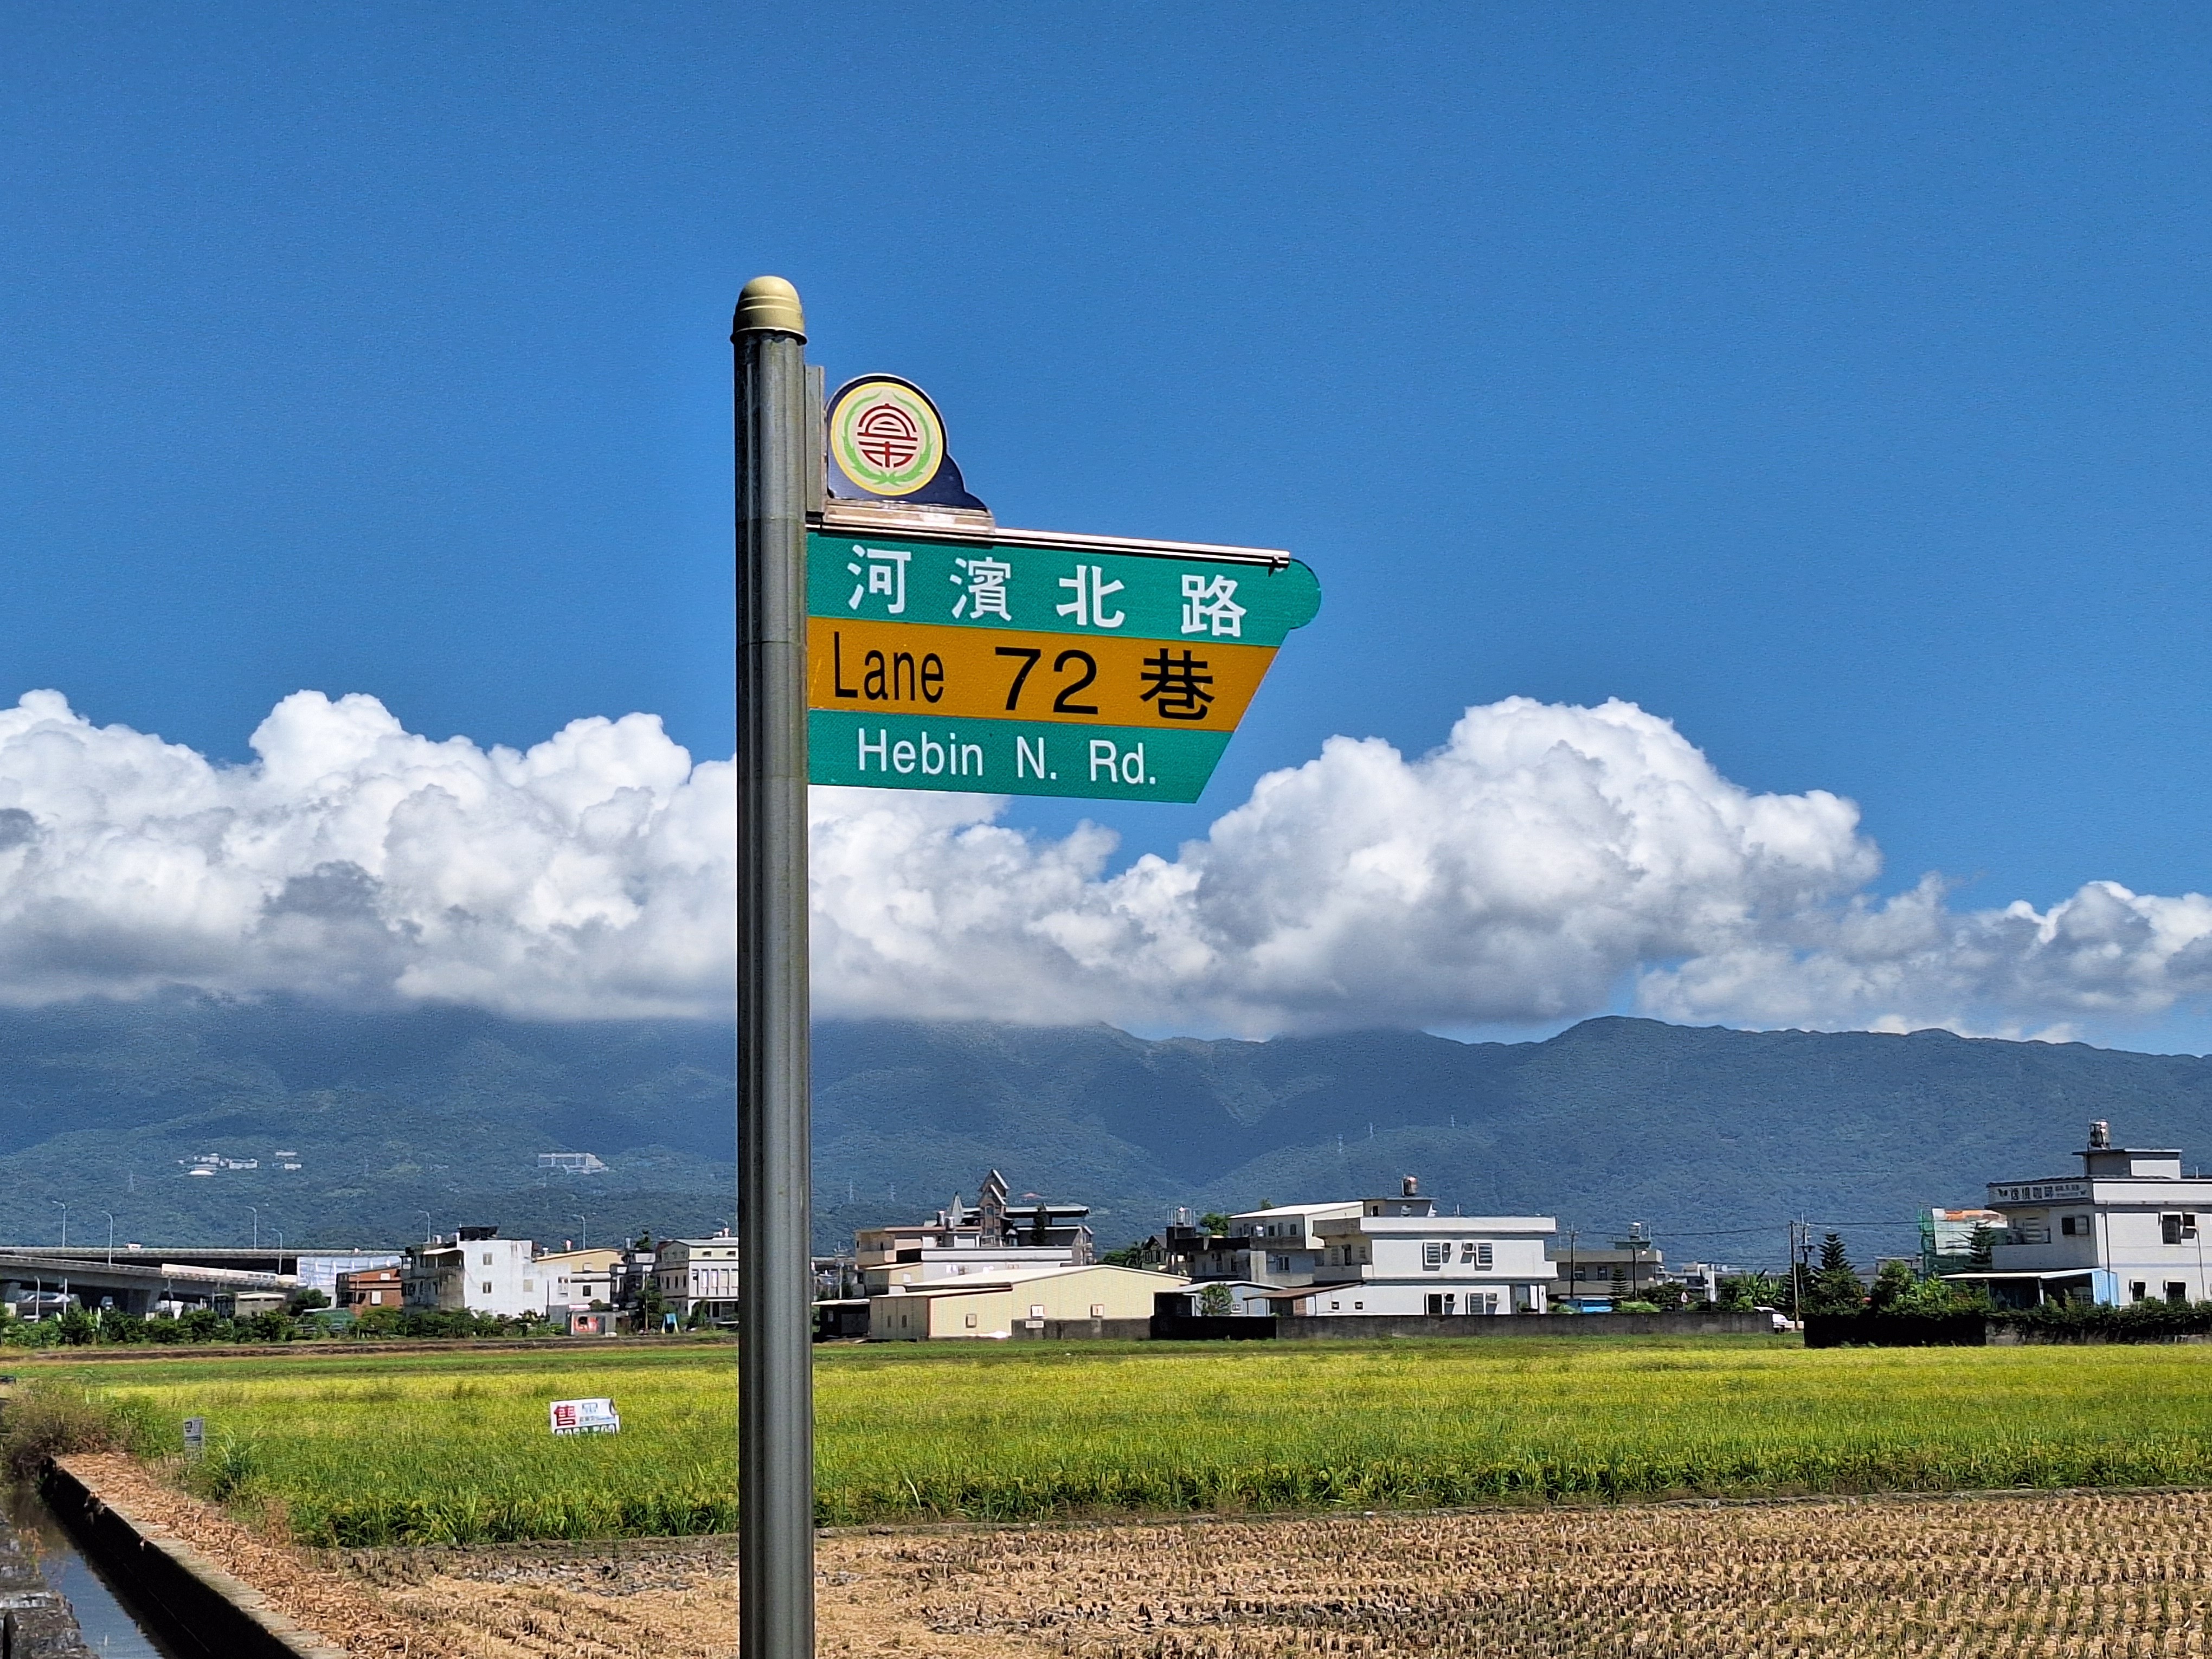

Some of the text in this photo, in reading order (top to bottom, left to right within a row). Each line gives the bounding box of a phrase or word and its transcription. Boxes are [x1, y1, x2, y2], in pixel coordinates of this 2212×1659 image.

[847, 544, 1247, 638] 河濱北路
[833, 631, 944, 704] Lane
[994, 646, 1099, 716] 72
[858, 728, 1156, 785] Hebin N. Rd.
[554, 1404, 576, 1426] 售
